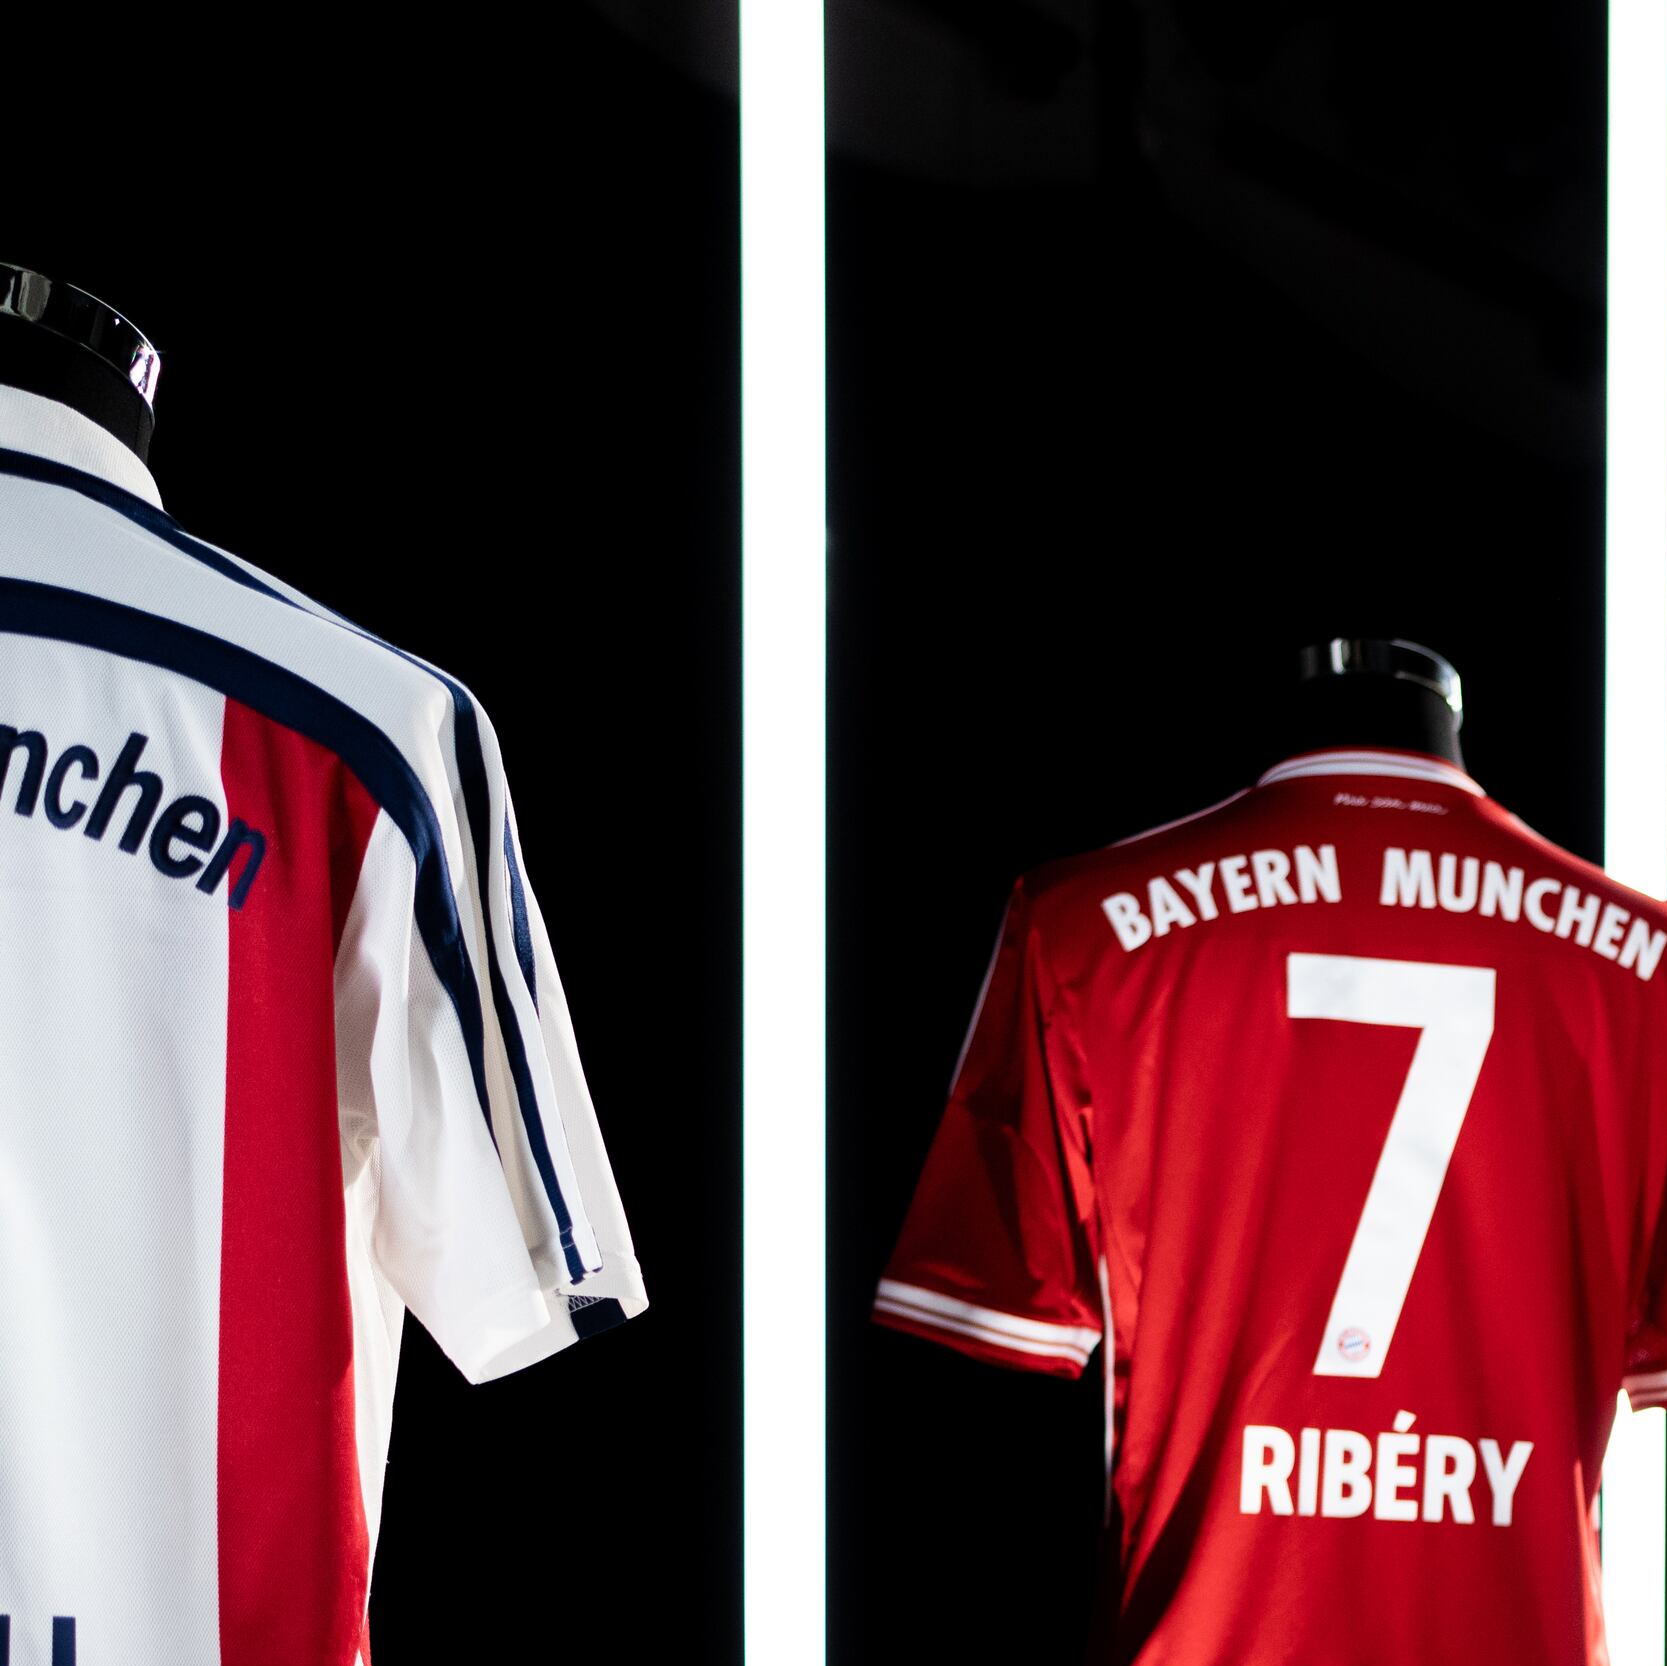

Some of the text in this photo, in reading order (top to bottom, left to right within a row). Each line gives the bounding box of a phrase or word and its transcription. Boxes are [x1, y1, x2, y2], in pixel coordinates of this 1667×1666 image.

[1102, 844, 1342, 952] BAYERN
[1287, 953, 1497, 1379] 7
[1240, 1410, 1534, 1527] RIBÉRY
